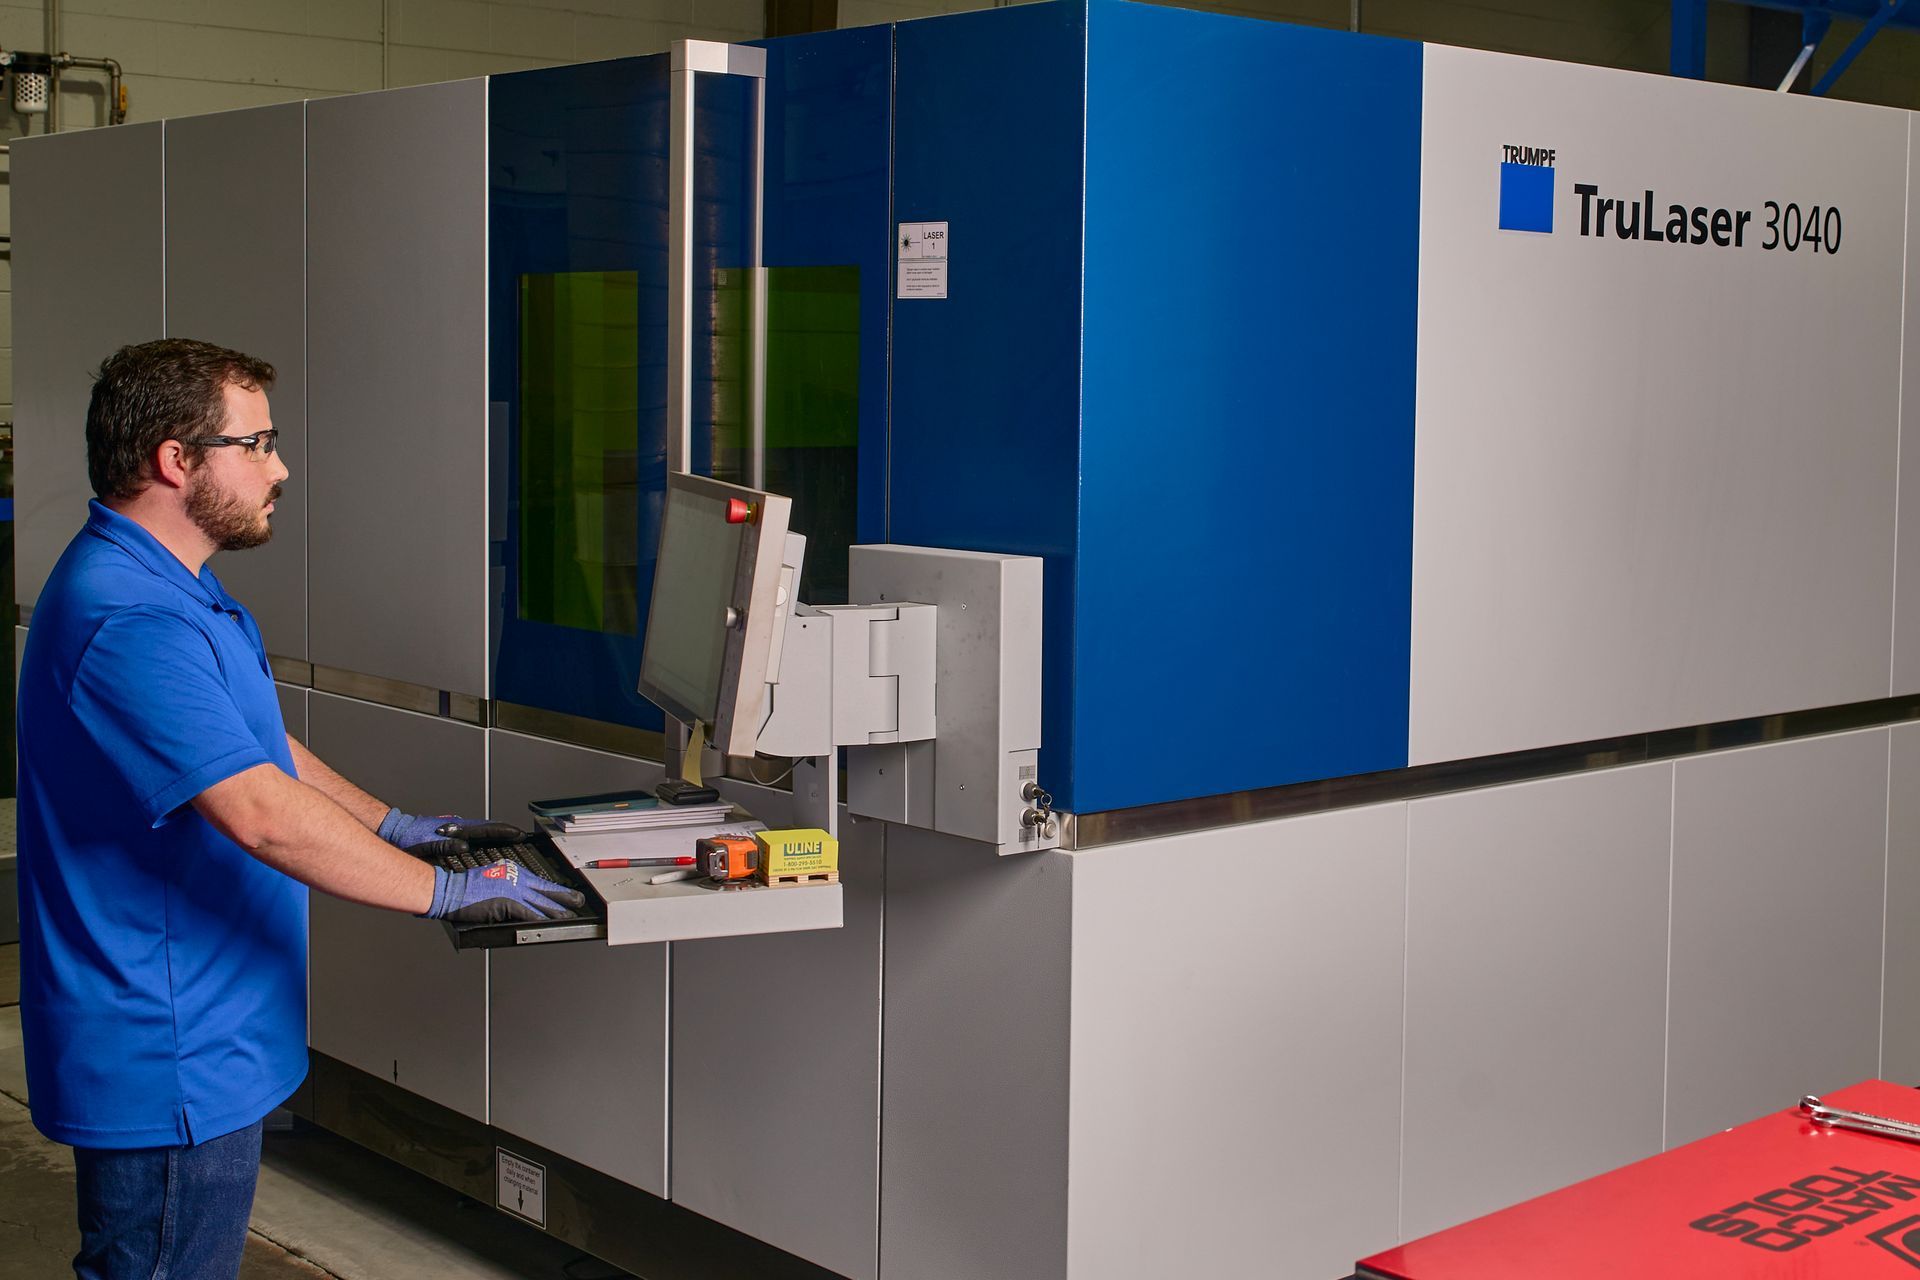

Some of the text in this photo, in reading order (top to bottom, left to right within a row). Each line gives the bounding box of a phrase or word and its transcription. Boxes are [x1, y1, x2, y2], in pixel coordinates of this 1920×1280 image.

[1502, 144, 1556, 167] TRUMPF
[1574, 183, 1842, 255] TruLaser 3040
[786, 842, 820, 854] ULINE
[502, 1156, 514, 1168] Empty
[522, 1166, 540, 1177] container
[506, 1168, 536, 1185] daily and when
[504, 1176, 538, 1195] changing material
[1689, 1166, 1893, 1237] TOOLS
[1740, 1174, 1920, 1252] MATCO
